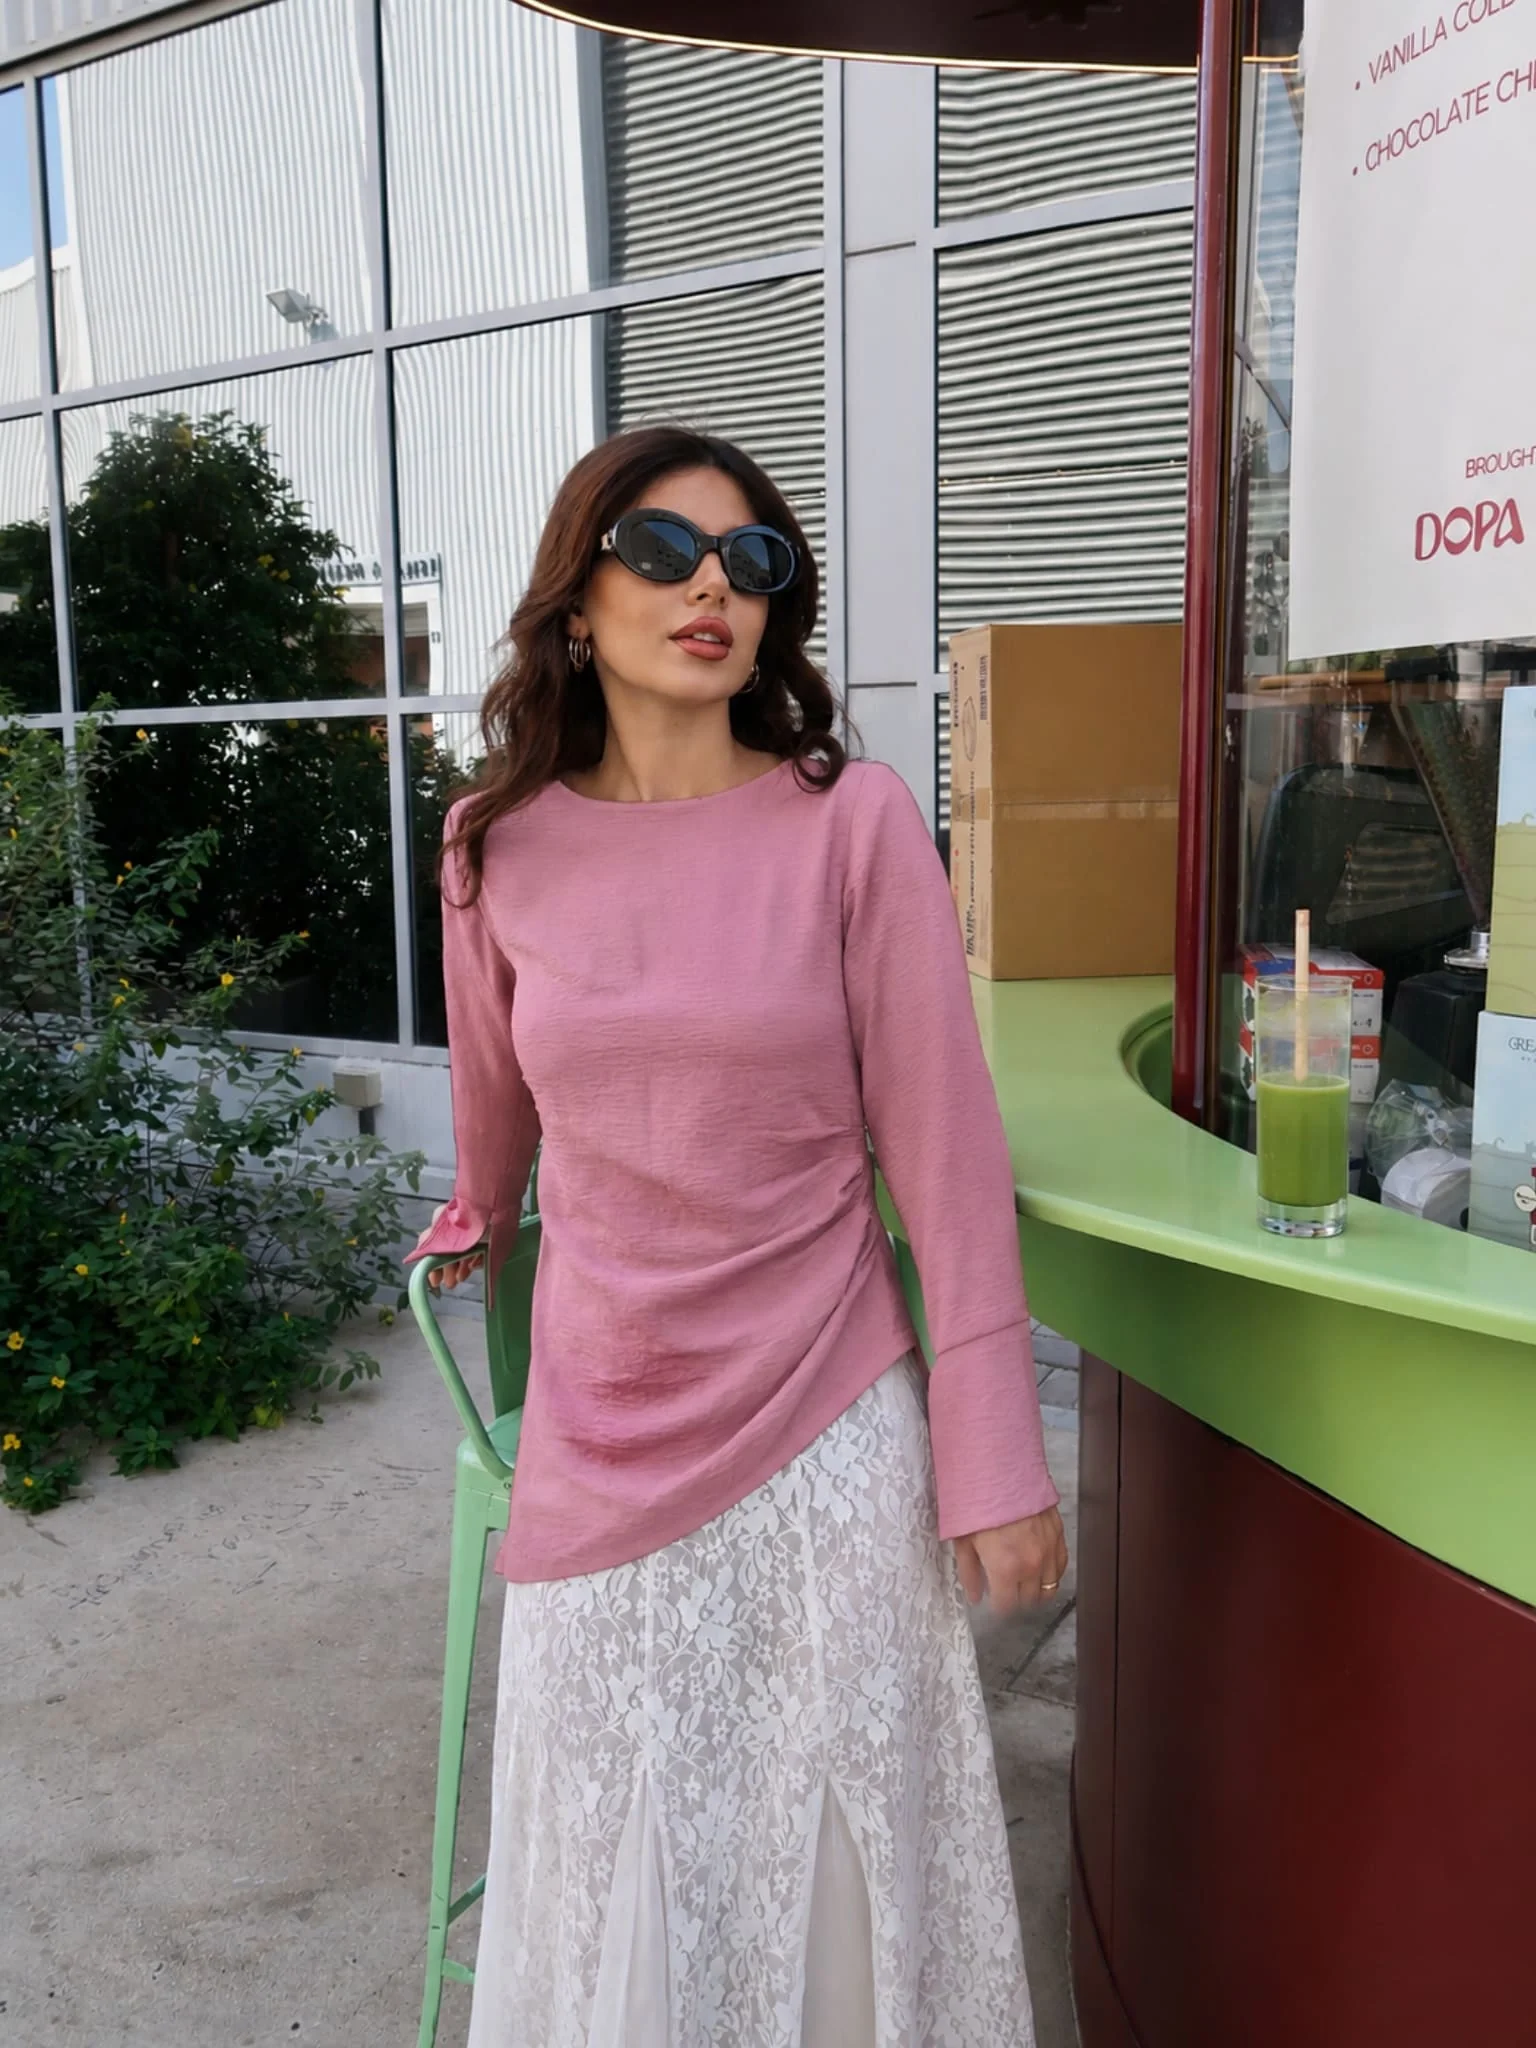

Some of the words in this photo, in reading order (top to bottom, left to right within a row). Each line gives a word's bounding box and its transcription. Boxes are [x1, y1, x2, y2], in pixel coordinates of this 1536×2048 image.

[1369, 16, 1448, 84] VANILLA
[1365, 81, 1490, 171] CHOCOLATE
[1415, 498, 1525, 561] DOPA
